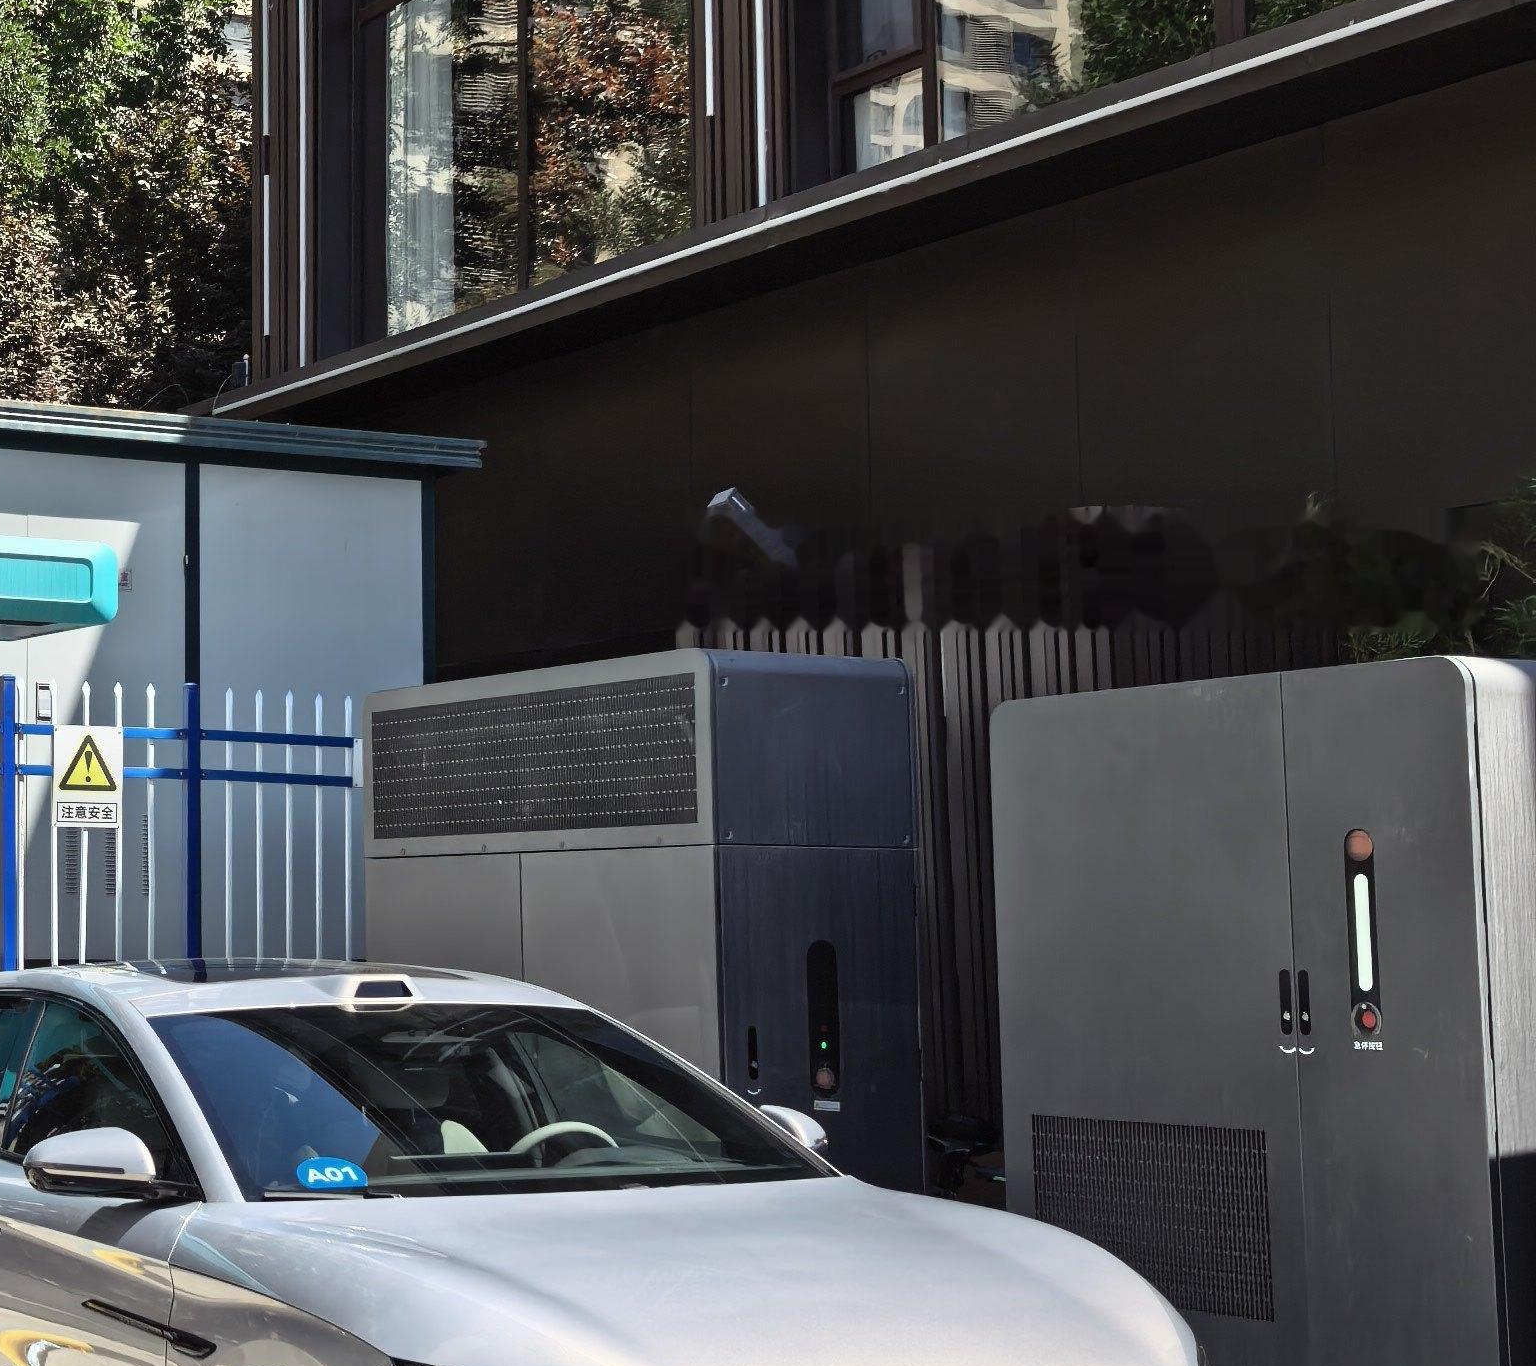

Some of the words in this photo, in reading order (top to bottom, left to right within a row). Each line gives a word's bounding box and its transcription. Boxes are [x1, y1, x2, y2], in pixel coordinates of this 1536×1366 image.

[61, 805, 114, 820] 注意安全
[308, 1166, 359, 1183] A01
